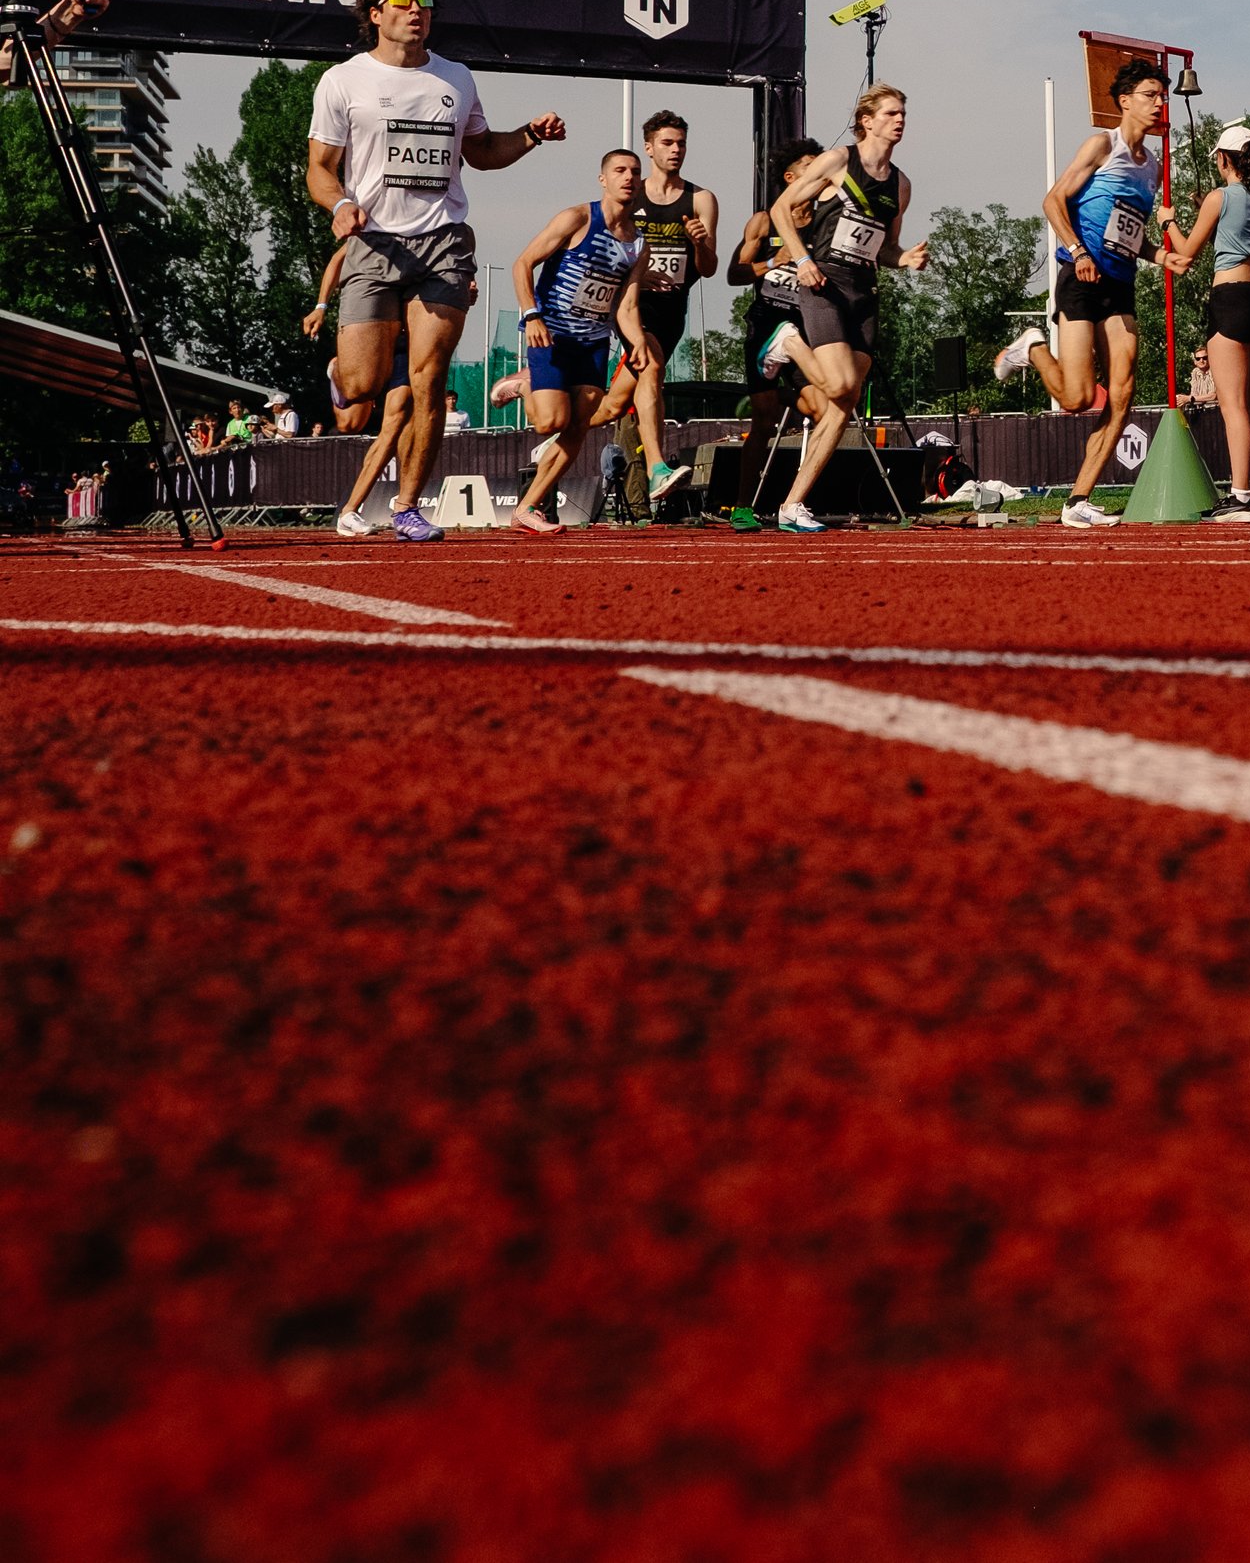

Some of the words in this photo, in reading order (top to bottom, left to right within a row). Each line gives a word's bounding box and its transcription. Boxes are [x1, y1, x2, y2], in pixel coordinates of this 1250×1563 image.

[388, 146, 452, 166] PACER
[850, 226, 875, 246] 47
[1117, 214, 1142, 239] 557
[583, 282, 614, 303] 400
[1121, 434, 1142, 460] TN
[416, 496, 438, 508] TRA
[495, 495, 519, 506] VIE
[459, 483, 474, 516] 1
